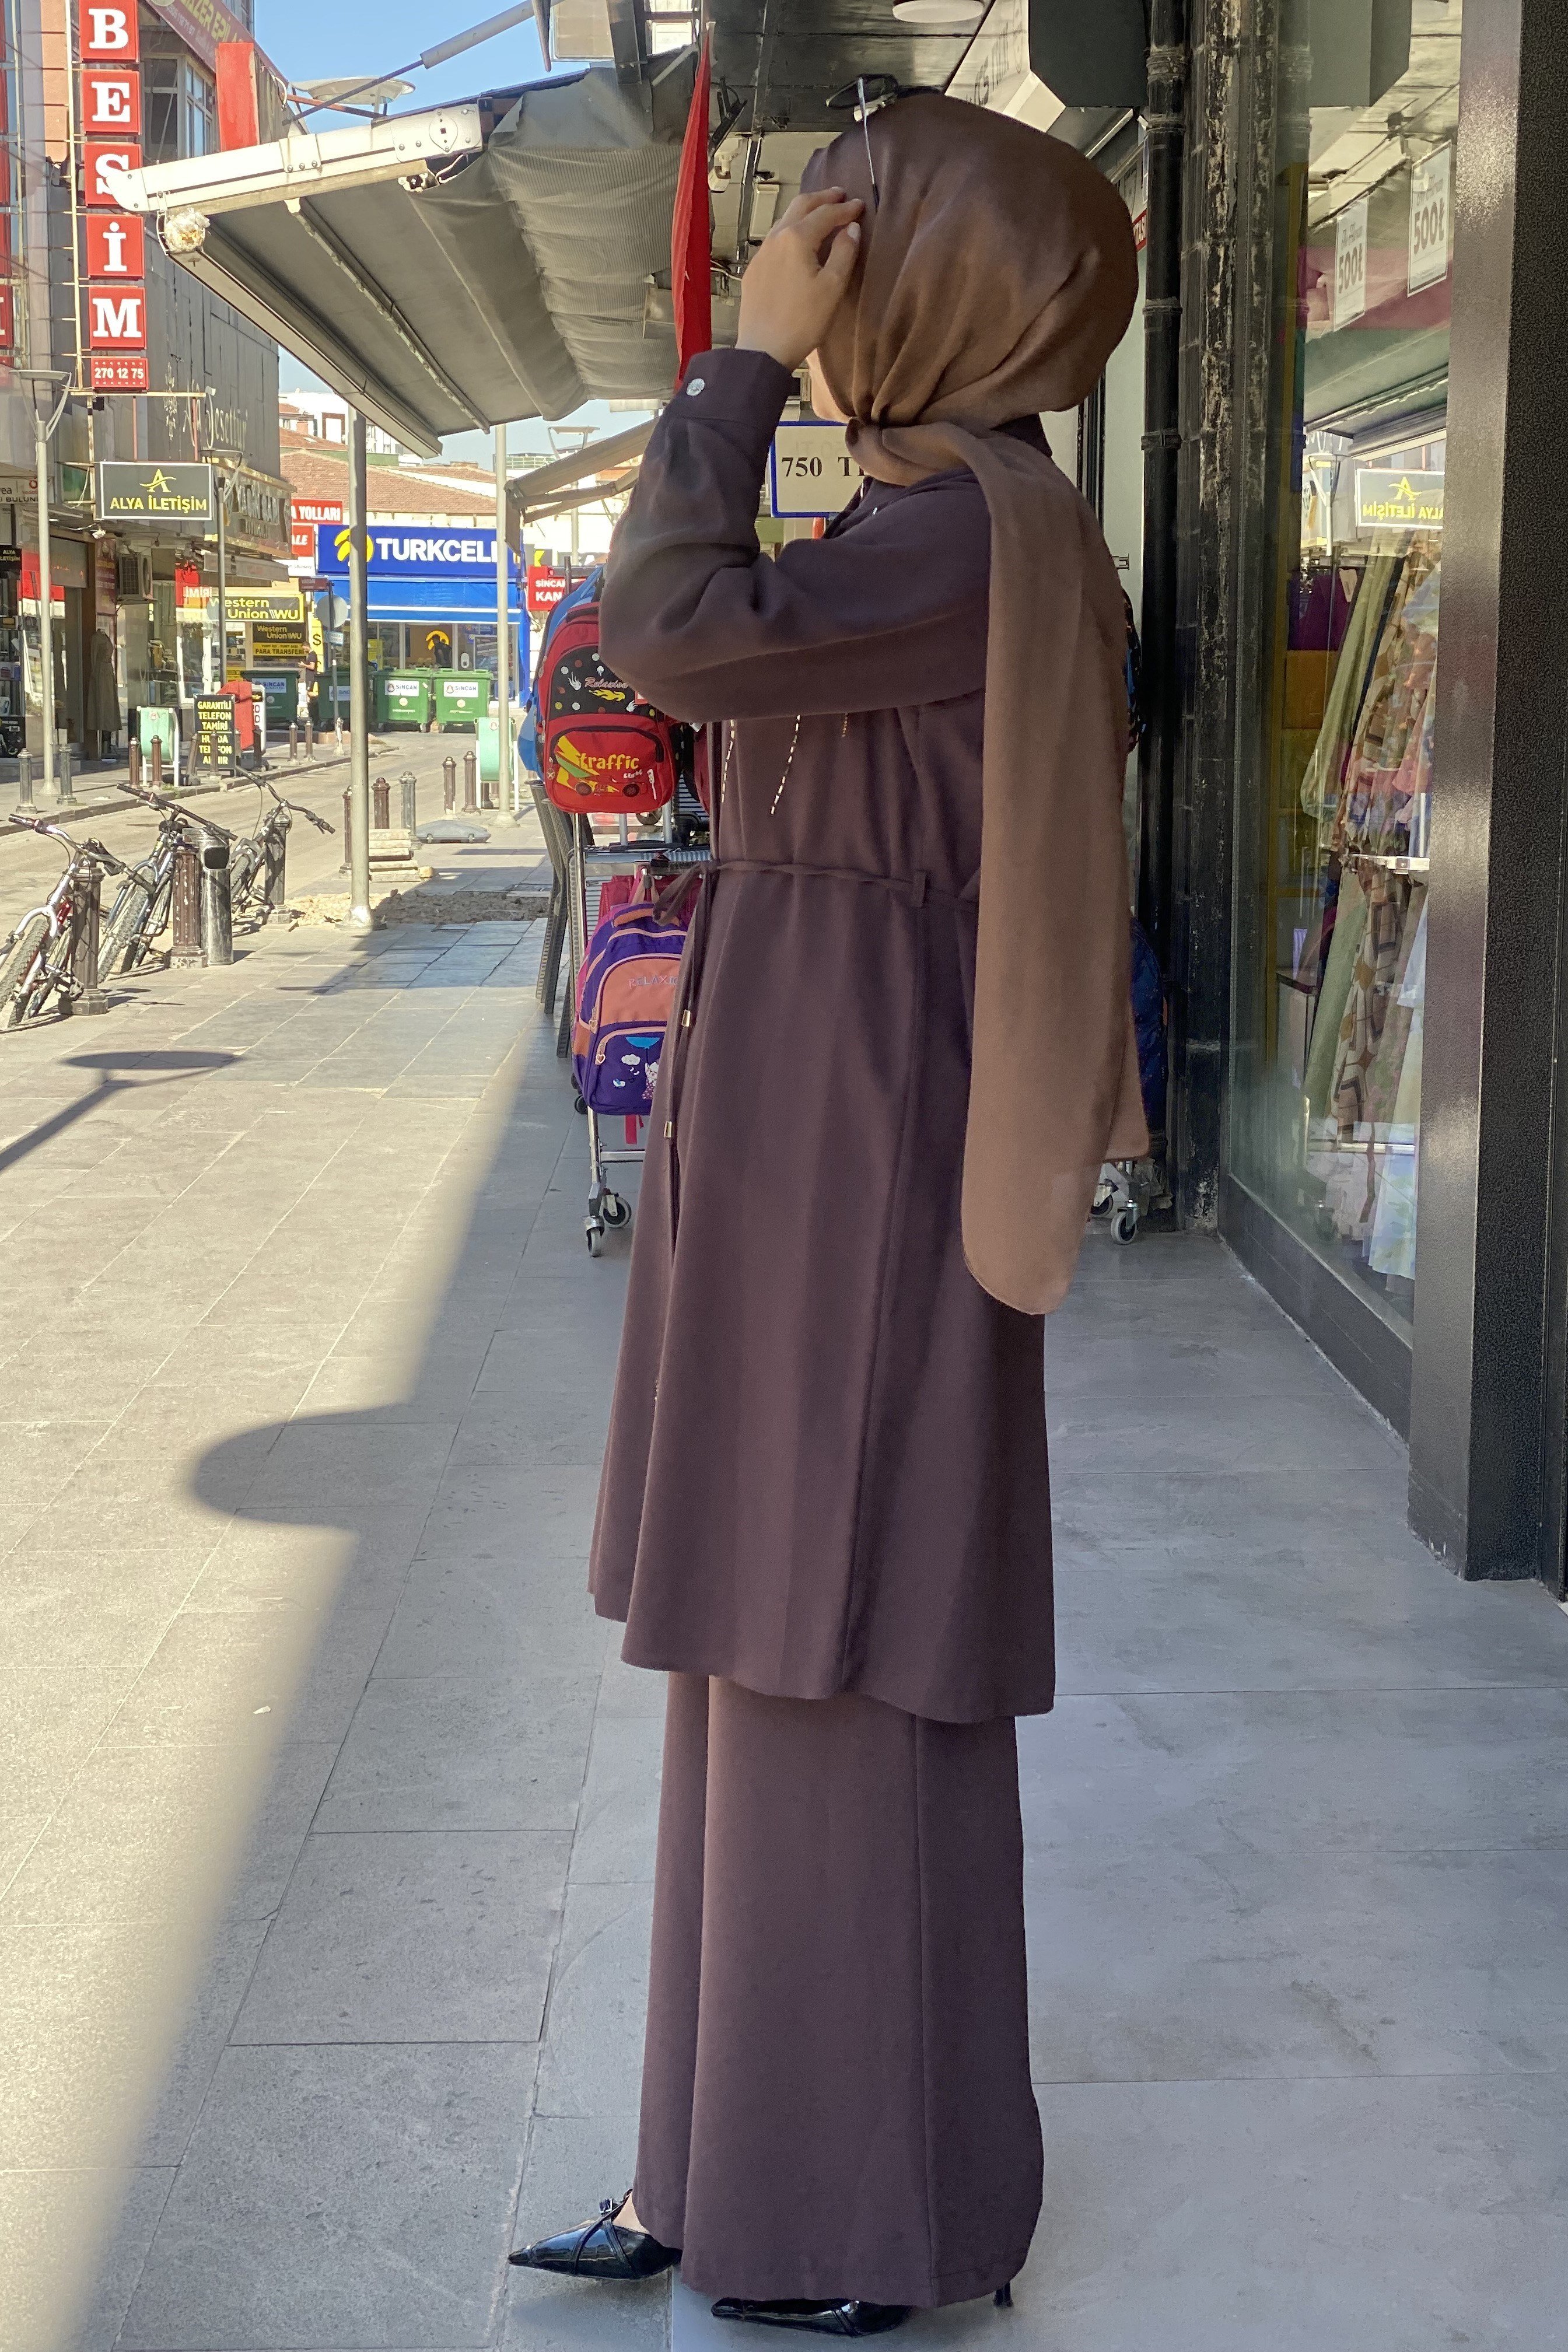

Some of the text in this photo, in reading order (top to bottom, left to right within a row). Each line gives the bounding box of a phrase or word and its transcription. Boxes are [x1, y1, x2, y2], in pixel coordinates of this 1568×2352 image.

[94, 368, 144, 379] 270 12 75
[781, 457, 822, 477] 750
[110, 495, 207, 513] ALYA İLETİŞİM
[299, 506, 341, 521] YOLLARI
[209, 597, 270, 607] Western
[228, 608, 268, 619] Union
[257, 625, 287, 633] Western
[198, 700, 232, 710] GARANTİLİ
[198, 711, 232, 720] TELEFON
[202, 720, 228, 730] TAMİRİ
[201, 734, 228, 743] HUDA
